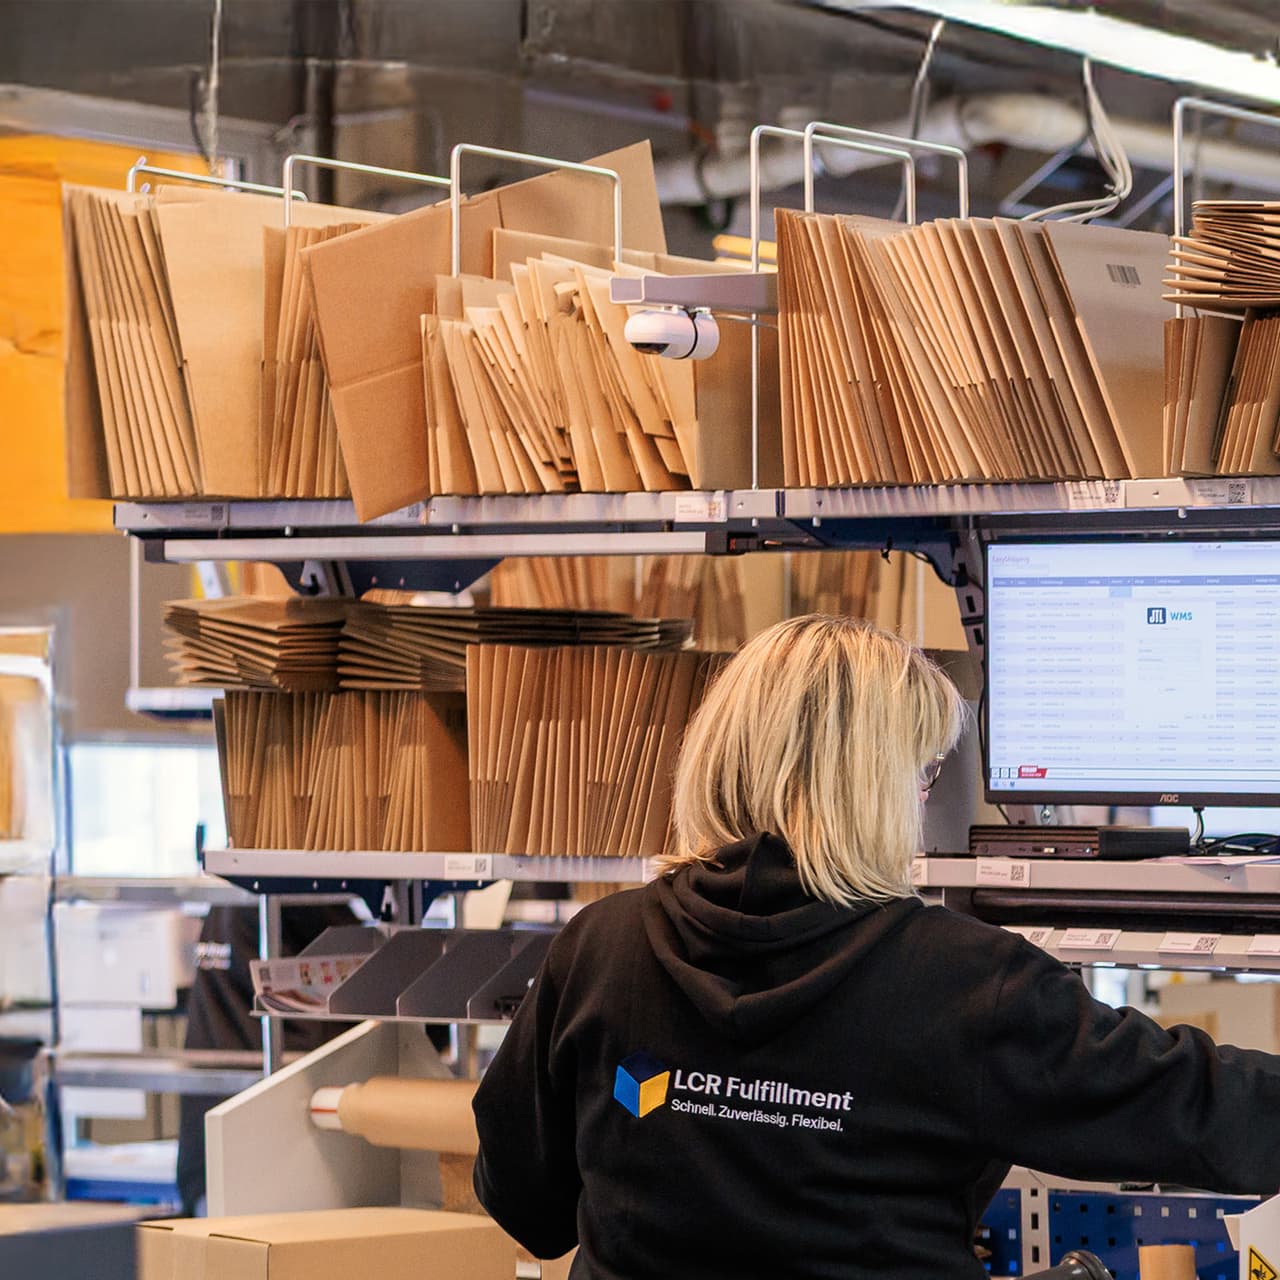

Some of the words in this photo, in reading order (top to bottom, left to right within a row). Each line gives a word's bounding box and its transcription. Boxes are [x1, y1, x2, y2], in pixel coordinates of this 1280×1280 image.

[1170, 611, 1193, 621] WMS
[1159, 794, 1180, 803] AOC
[674, 1069, 722, 1095] LCR
[726, 1077, 854, 1111] Fulfillment
[671, 1099, 717, 1116] Schnell.
[718, 1105, 789, 1127] Zuverlässig.
[791, 1114, 844, 1132] Flexibel.
